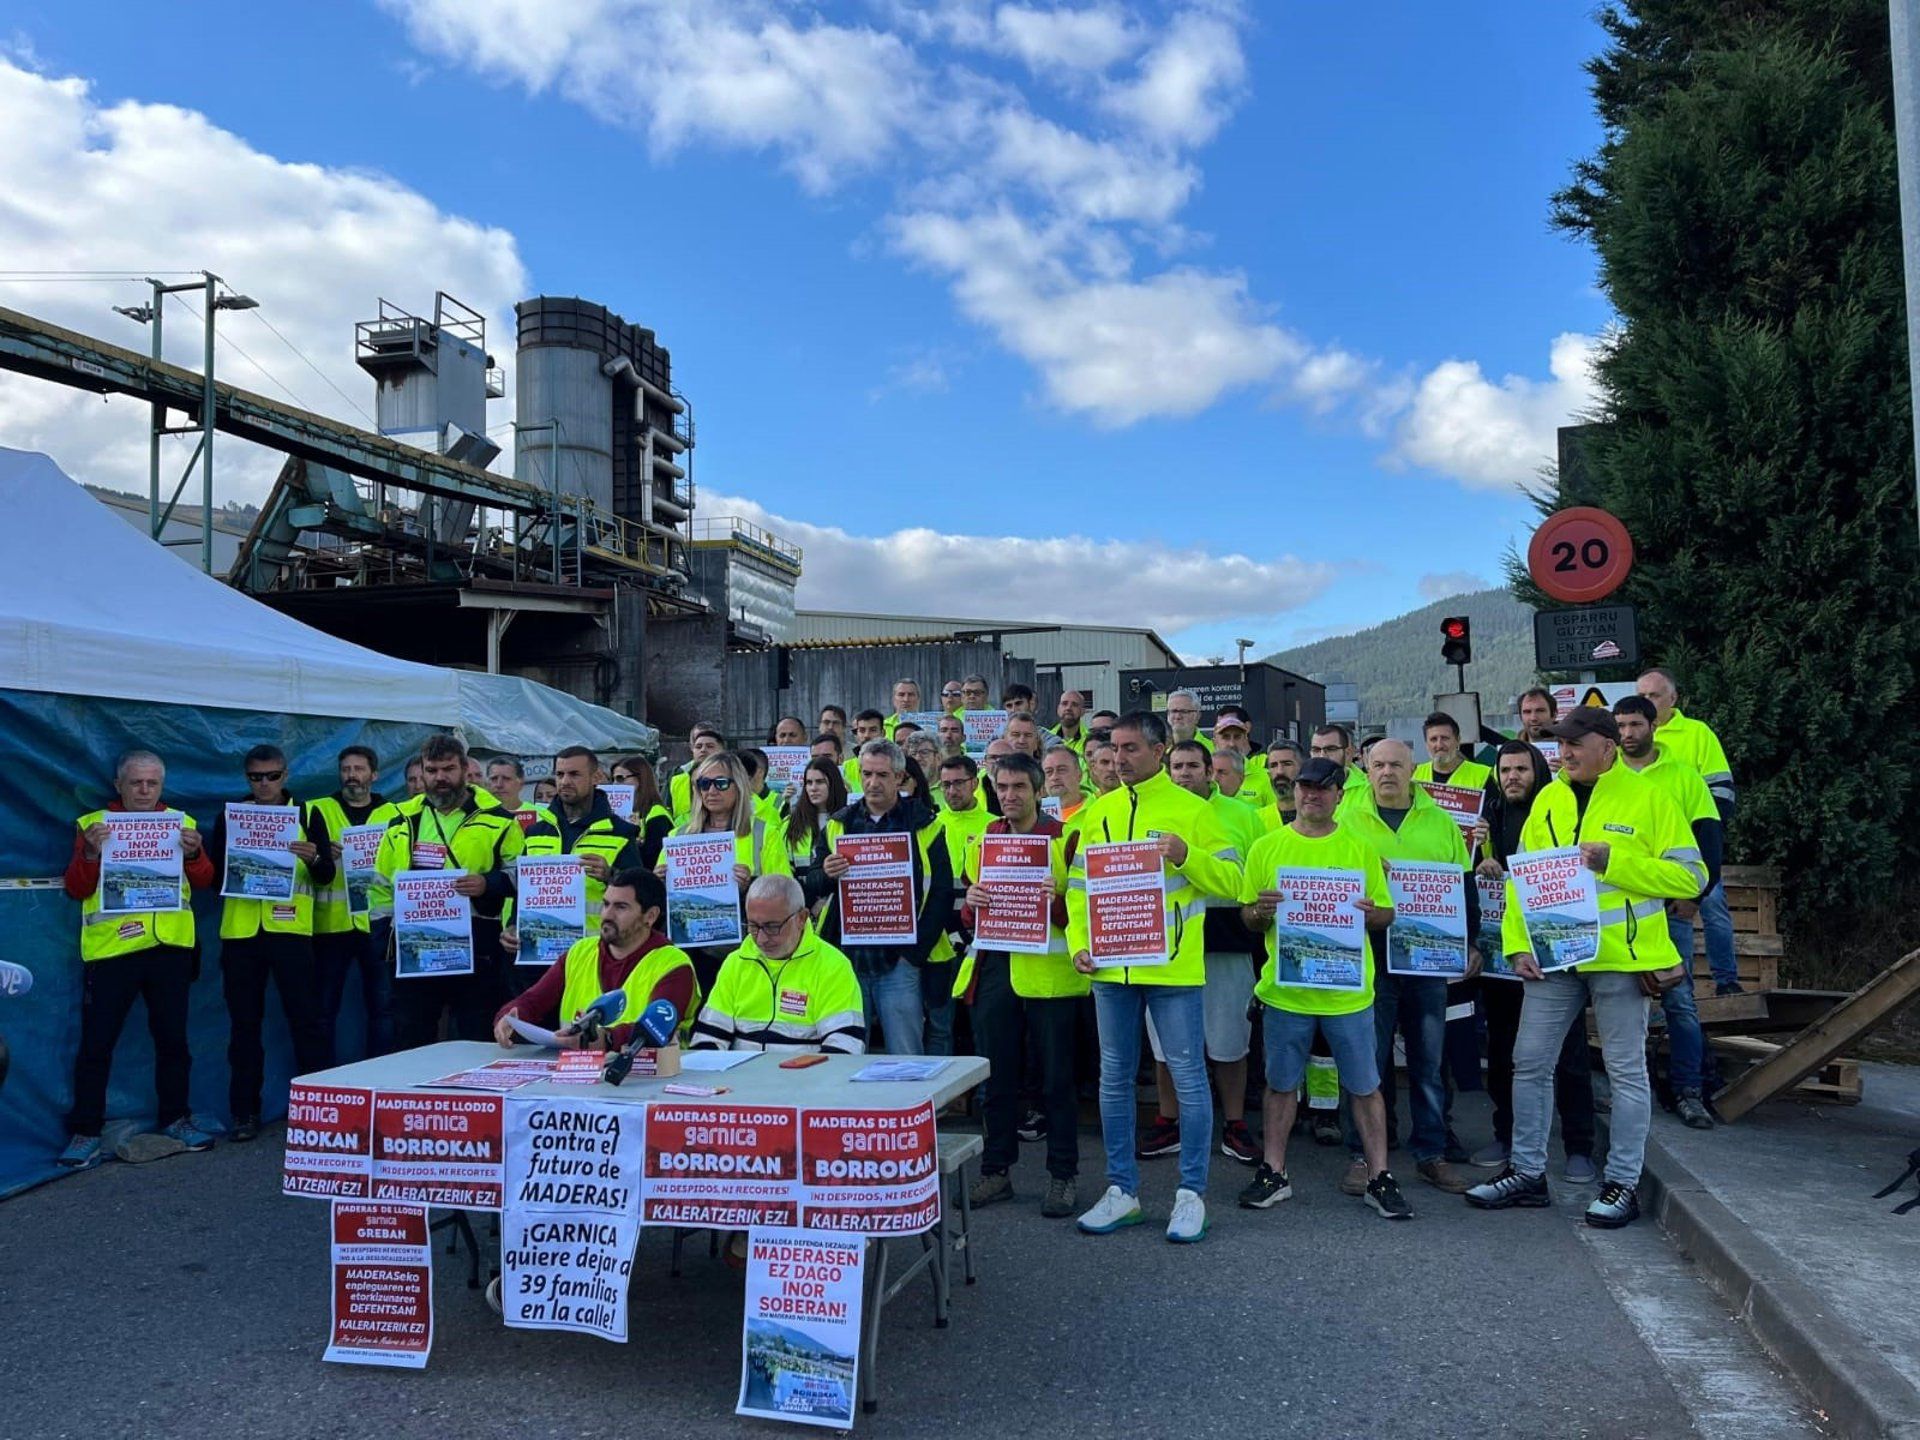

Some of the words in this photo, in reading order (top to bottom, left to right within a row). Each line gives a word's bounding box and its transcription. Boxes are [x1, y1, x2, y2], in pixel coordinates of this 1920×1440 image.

[1552, 538, 1609, 572] 20
[1553, 612, 1618, 626] ESPARRU
[1556, 623, 1616, 637] GUZTIAN
[1557, 641, 1574, 653] EN
[1549, 655, 1563, 664] EL
[229, 813, 296, 824] MADERASEN
[107, 822, 180, 831] MADERASEN
[255, 823, 285, 832] DAGO
[136, 832, 169, 840] DAGO
[250, 831, 276, 839] INOR
[128, 841, 158, 849] INOR
[666, 843, 732, 857] MADERASEN
[112, 849, 173, 858] SOBERAN!
[854, 853, 893, 861] GREBAN
[995, 855, 1031, 863] GREBAN
[676, 858, 687, 867] EZ
[690, 854, 722, 866] DAGO
[520, 865, 582, 876] MADERASEN
[685, 865, 711, 876] INOR
[1104, 863, 1143, 873] GREBAN
[530, 877, 542, 885] EZ
[545, 876, 572, 885] DAGO
[673, 874, 728, 887] SOBERAN!
[1391, 872, 1461, 884] MADERASEN
[1525, 876, 1540, 885] EZ
[1542, 868, 1577, 881] DAGO
[538, 886, 562, 895] INOR
[1280, 880, 1360, 893] MADERASEN
[1403, 883, 1417, 892] EZ
[1420, 883, 1452, 894] DAGO
[1538, 880, 1567, 894] INOR
[424, 889, 455, 899] DAGO
[525, 896, 576, 905] SOBERAN!
[1097, 894, 1155, 905] MADERASeko
[1292, 891, 1308, 900] EZ
[1312, 892, 1348, 902] DAGO
[1413, 893, 1442, 903] INOR
[1527, 888, 1584, 907] SOBERAN!
[418, 900, 445, 909] INOR
[1304, 902, 1336, 913] INOR
[1397, 903, 1457, 914] SOBERAN!
[404, 908, 461, 919] SOBERAN!
[1287, 911, 1353, 924] SOBERAN!
[1095, 933, 1147, 943] KALERATZERIK
[307, 1092, 322, 1102] DE
[324, 1093, 366, 1105] LLODIO
[377, 1099, 432, 1111] MADERAS
[434, 1101, 450, 1111] DE
[452, 1102, 496, 1113] LLODIO
[403, 1114, 468, 1132] garnica
[528, 1111, 620, 1134] GARNICA
[655, 1111, 717, 1123] MADERAS
[720, 1113, 737, 1123] DE
[740, 1113, 788, 1125] LLODIO
[809, 1116, 875, 1128] MADERAS
[878, 1118, 896, 1128] DE
[685, 1126, 757, 1146] garnica
[842, 1131, 918, 1152] garnica
[383, 1137, 491, 1158] BORROKAN
[532, 1132, 595, 1152] contra
[601, 1134, 619, 1155] el
[526, 1152, 594, 1179] futuro
[598, 1158, 620, 1179] de
[660, 1152, 781, 1174] BORROKAN
[815, 1152, 932, 1178] BORROKAN
[341, 1181, 362, 1195] EZ!
[736, 1186, 789, 1195] RECORTES!
[376, 1185, 474, 1204] KALERATZERIK
[475, 1191, 497, 1205] EZ!
[519, 1181, 628, 1209] MADERAS!
[827, 1192, 882, 1202] DESPIDOS,
[885, 1191, 898, 1199] NI
[337, 1205, 377, 1213] MADERAS
[394, 1206, 423, 1216] LLODIO
[652, 1205, 761, 1224] KALERATZERIK
[764, 1210, 789, 1225] EZ!
[811, 1209, 926, 1230] KALERATZERIK
[357, 1228, 406, 1239] GREBAN
[522, 1223, 617, 1248] ¡GARNICA
[506, 1245, 570, 1271] quiere
[576, 1246, 617, 1276] dejar
[620, 1260, 631, 1276] a
[753, 1246, 859, 1266] MADERASEN
[346, 1270, 419, 1282] MADERASeko
[769, 1263, 790, 1278] EZ
[794, 1265, 842, 1282] DAGO
[345, 1282, 403, 1293] enpleguaren
[405, 1285, 420, 1293] eta
[520, 1274, 546, 1294] 39
[547, 1273, 618, 1304] familias
[782, 1281, 825, 1298] INOR
[350, 1291, 415, 1303] etorkizunaren
[350, 1303, 417, 1316] DEFENTSAN!
[759, 1296, 846, 1318] SOBERAN!
[521, 1303, 545, 1320] en
[551, 1299, 570, 1321] la
[575, 1304, 616, 1330] calle!
[339, 1319, 408, 1332] KALERATZERIK
[410, 1323, 425, 1333] EZ!
